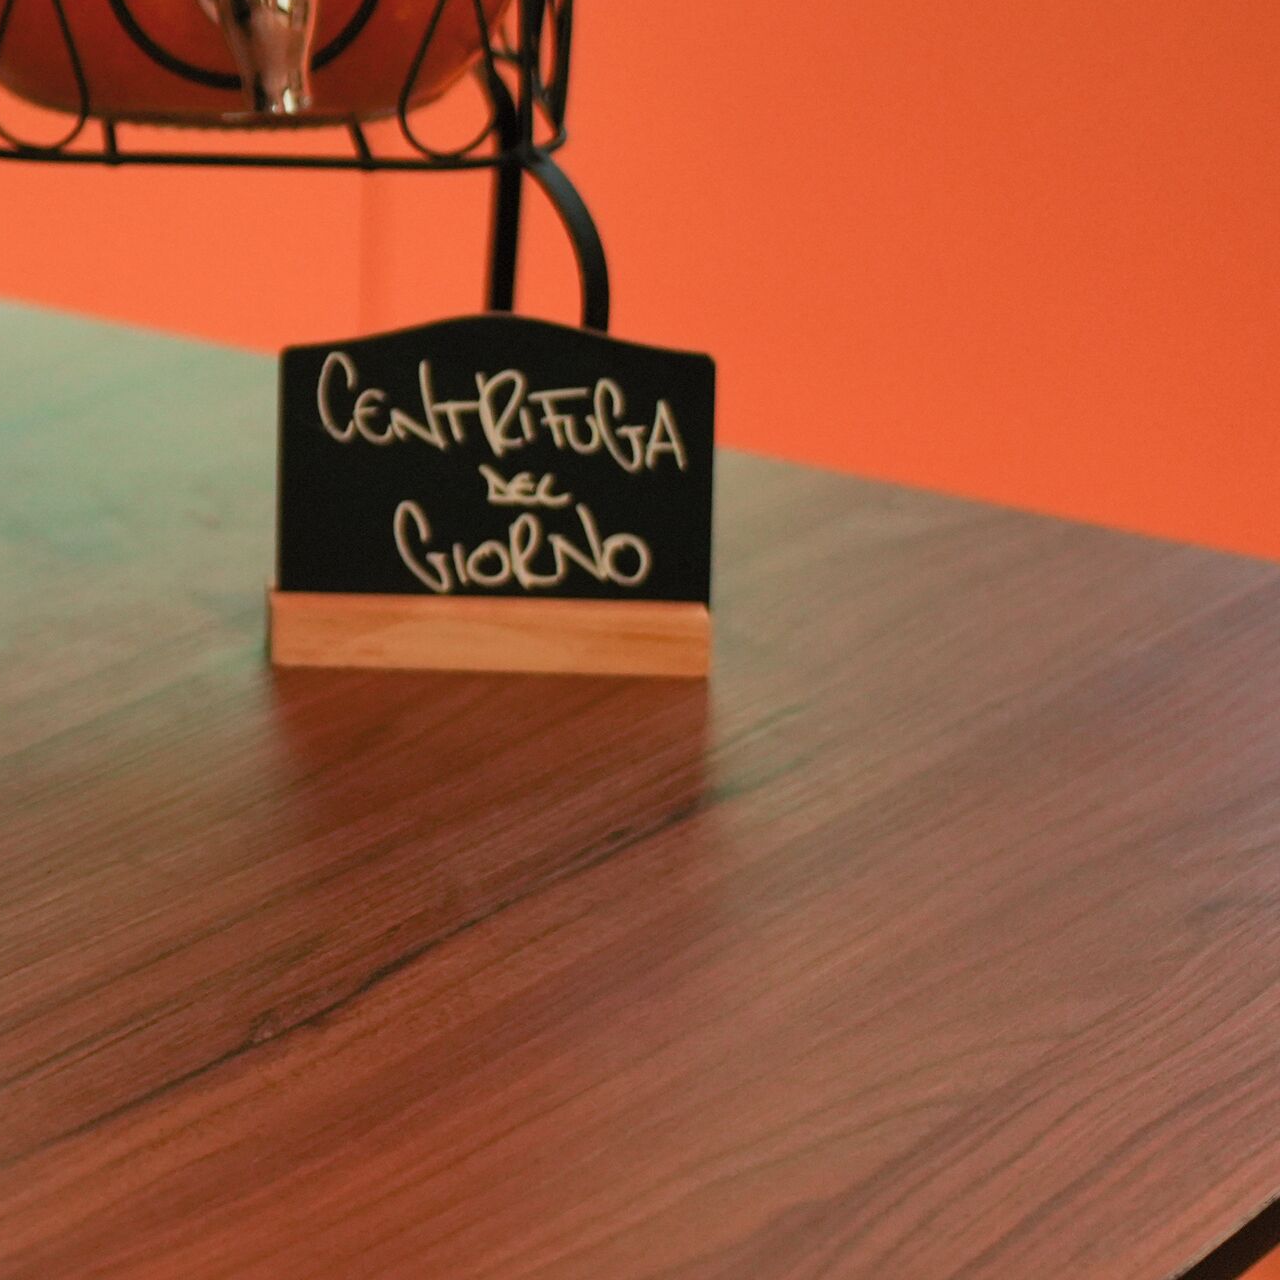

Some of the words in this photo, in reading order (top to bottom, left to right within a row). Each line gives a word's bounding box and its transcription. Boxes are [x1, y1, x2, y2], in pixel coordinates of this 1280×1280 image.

[317, 351, 688, 473] CENTRIFUGA
[478, 464, 571, 505] DEL
[393, 500, 652, 593] GIORNO
